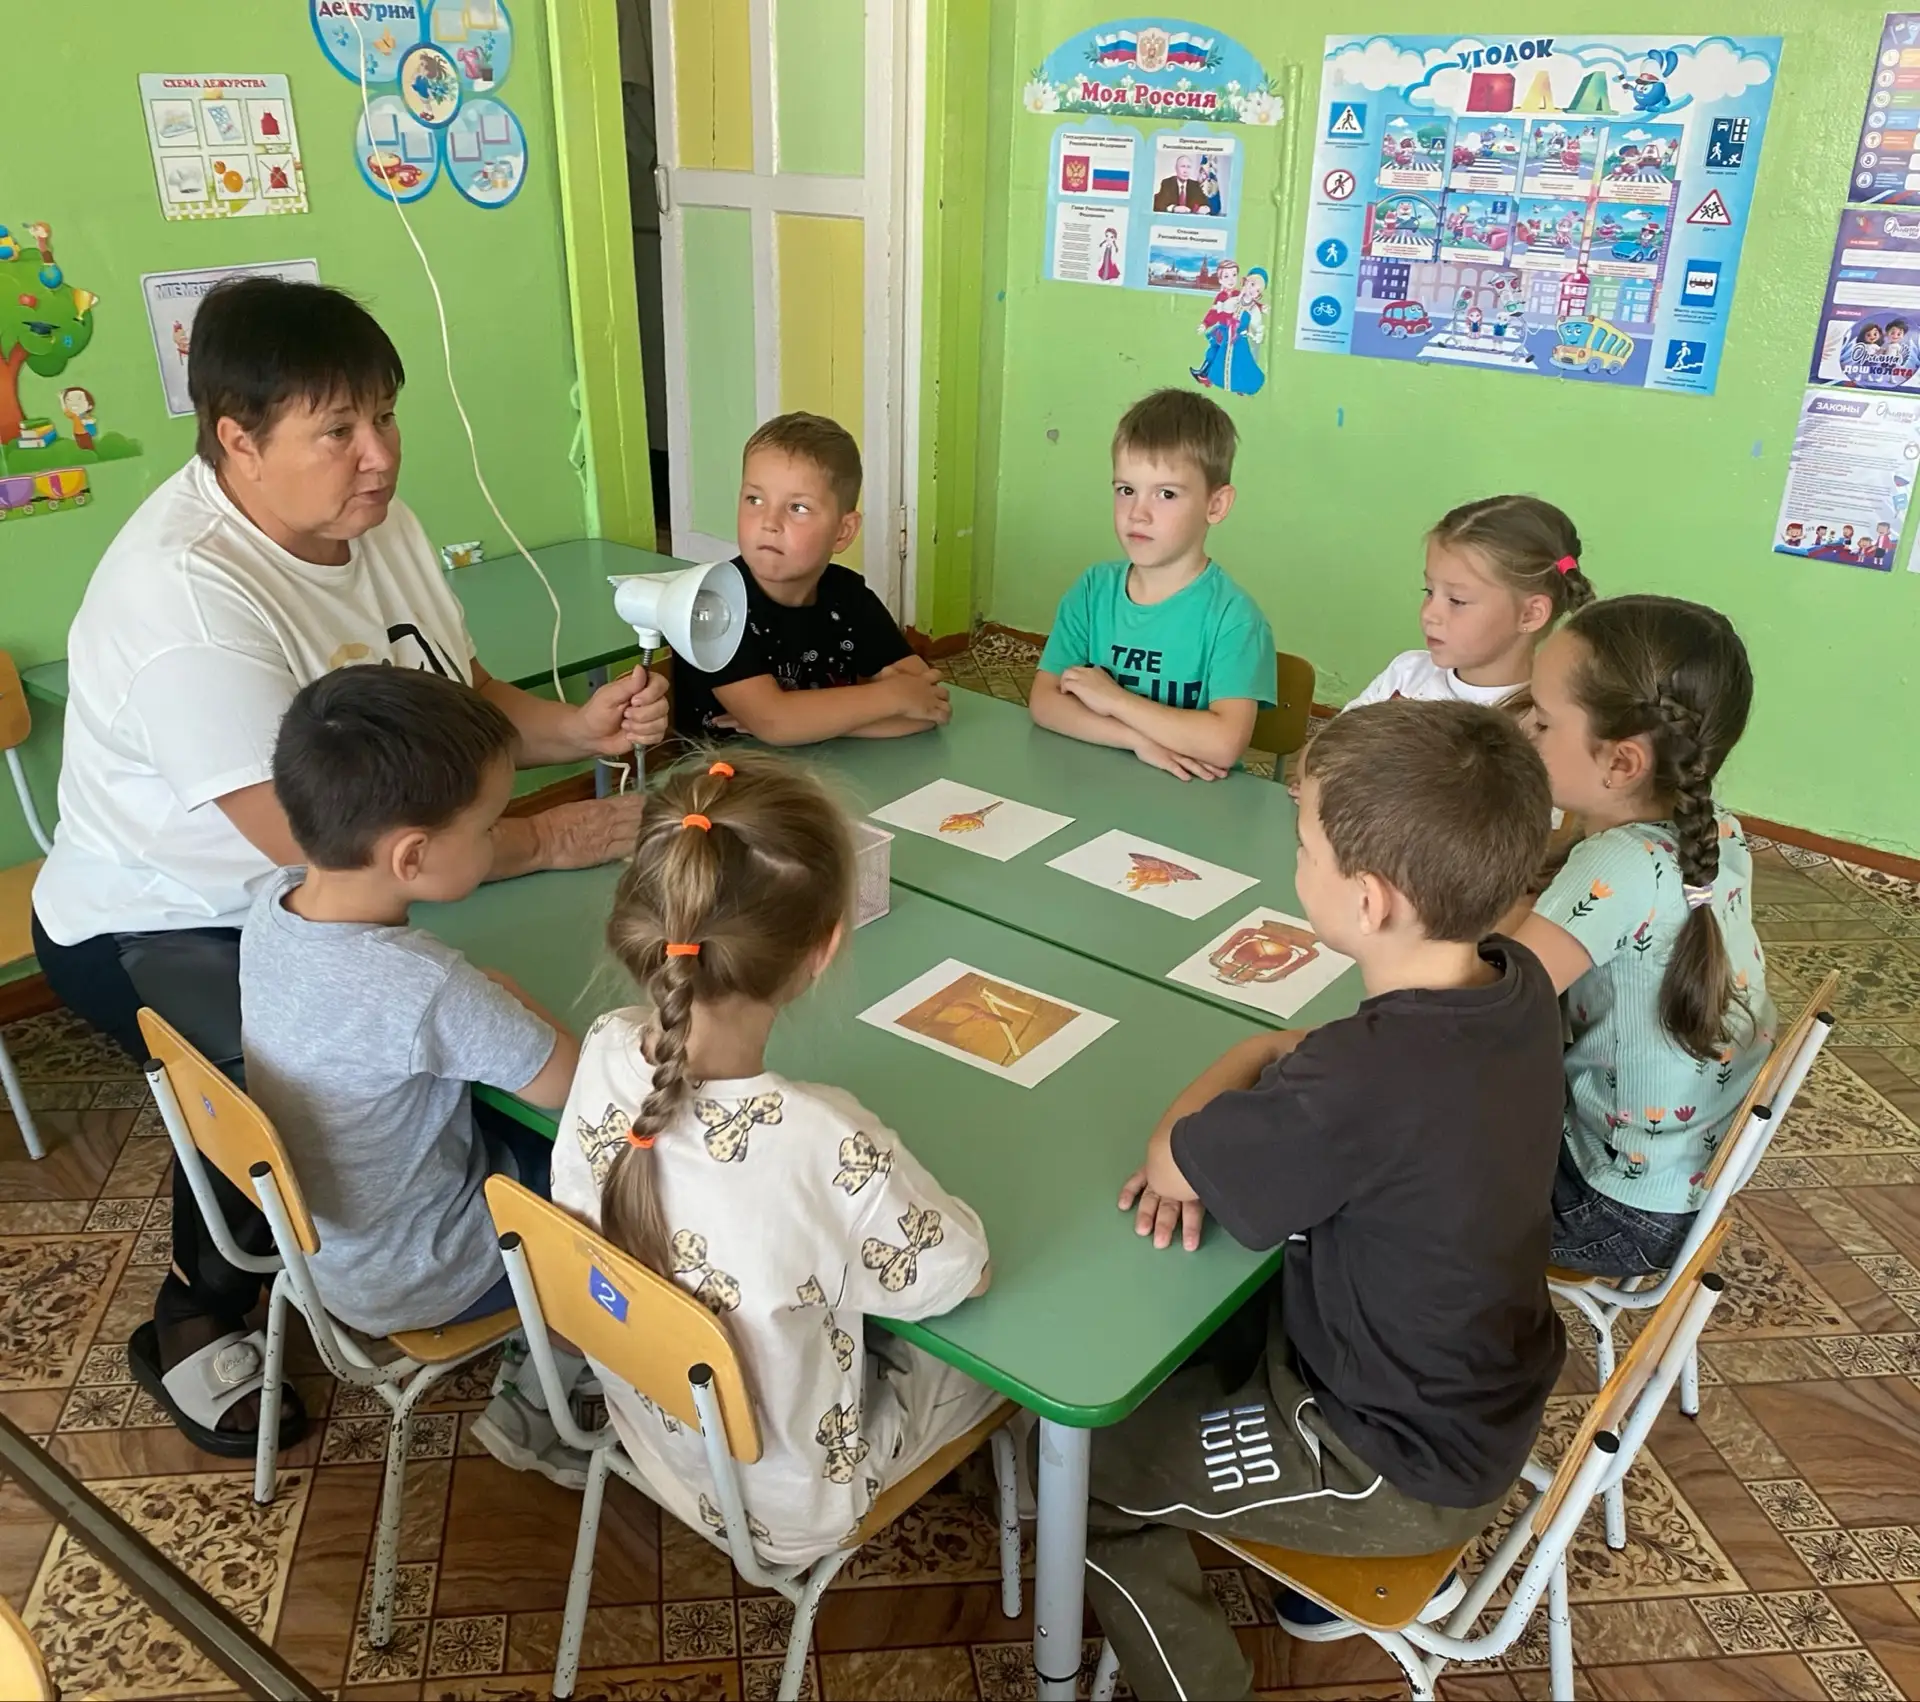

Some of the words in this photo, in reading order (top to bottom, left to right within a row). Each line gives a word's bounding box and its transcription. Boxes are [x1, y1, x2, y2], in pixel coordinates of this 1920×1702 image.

[1457, 39, 1554, 69] УГОЛОК
[163, 79, 200, 88] СХЕМА
[203, 79, 266, 88] ДЕЖУРСТВА
[1081, 82, 1127, 103] Моя
[1134, 84, 1217, 108] Россия
[1816, 401, 1861, 413] ЗАКОНЫ
[598, 1282, 616, 1312] 2
